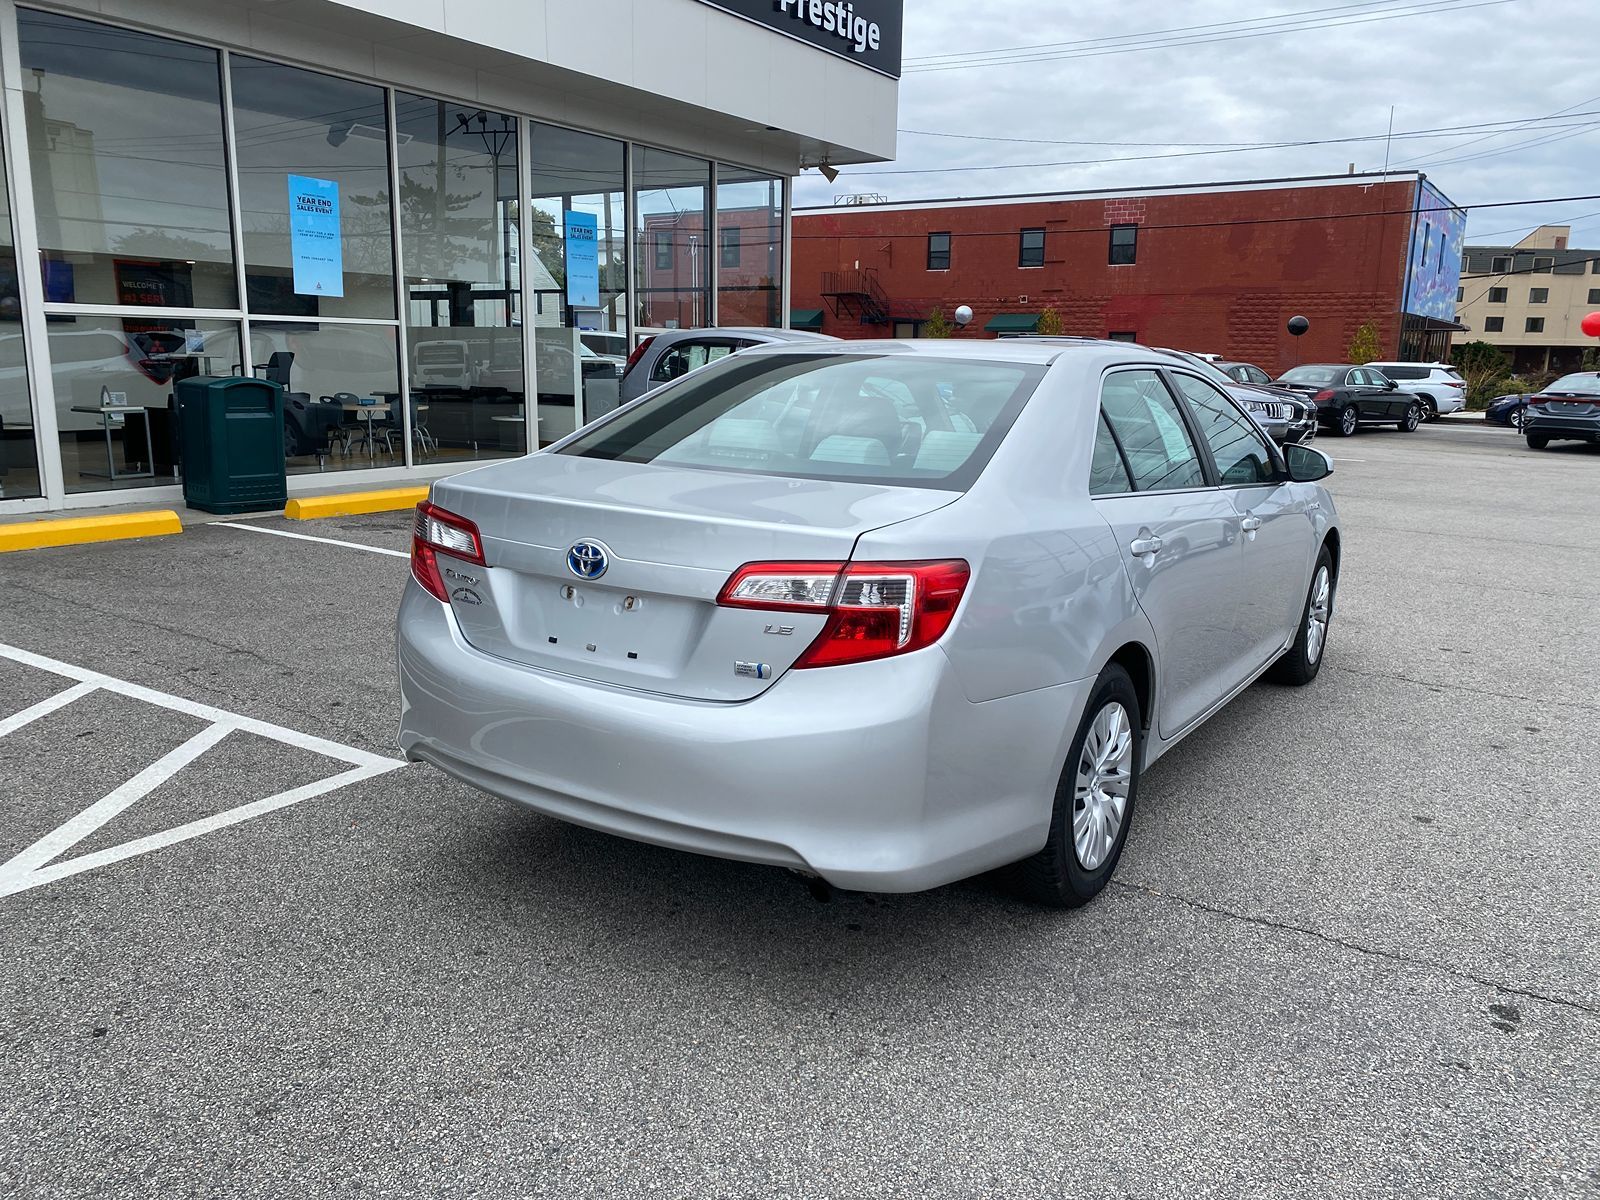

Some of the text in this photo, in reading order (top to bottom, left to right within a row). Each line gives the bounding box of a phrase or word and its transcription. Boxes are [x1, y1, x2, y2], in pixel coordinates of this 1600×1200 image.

[296, 195, 316, 205] YEAR
[317, 199, 332, 207] END
[296, 204, 333, 214] SALES EVENT
[570, 226, 583, 234] YEAR
[121, 281, 157, 290] WELCOME
[763, 624, 795, 636] LE
